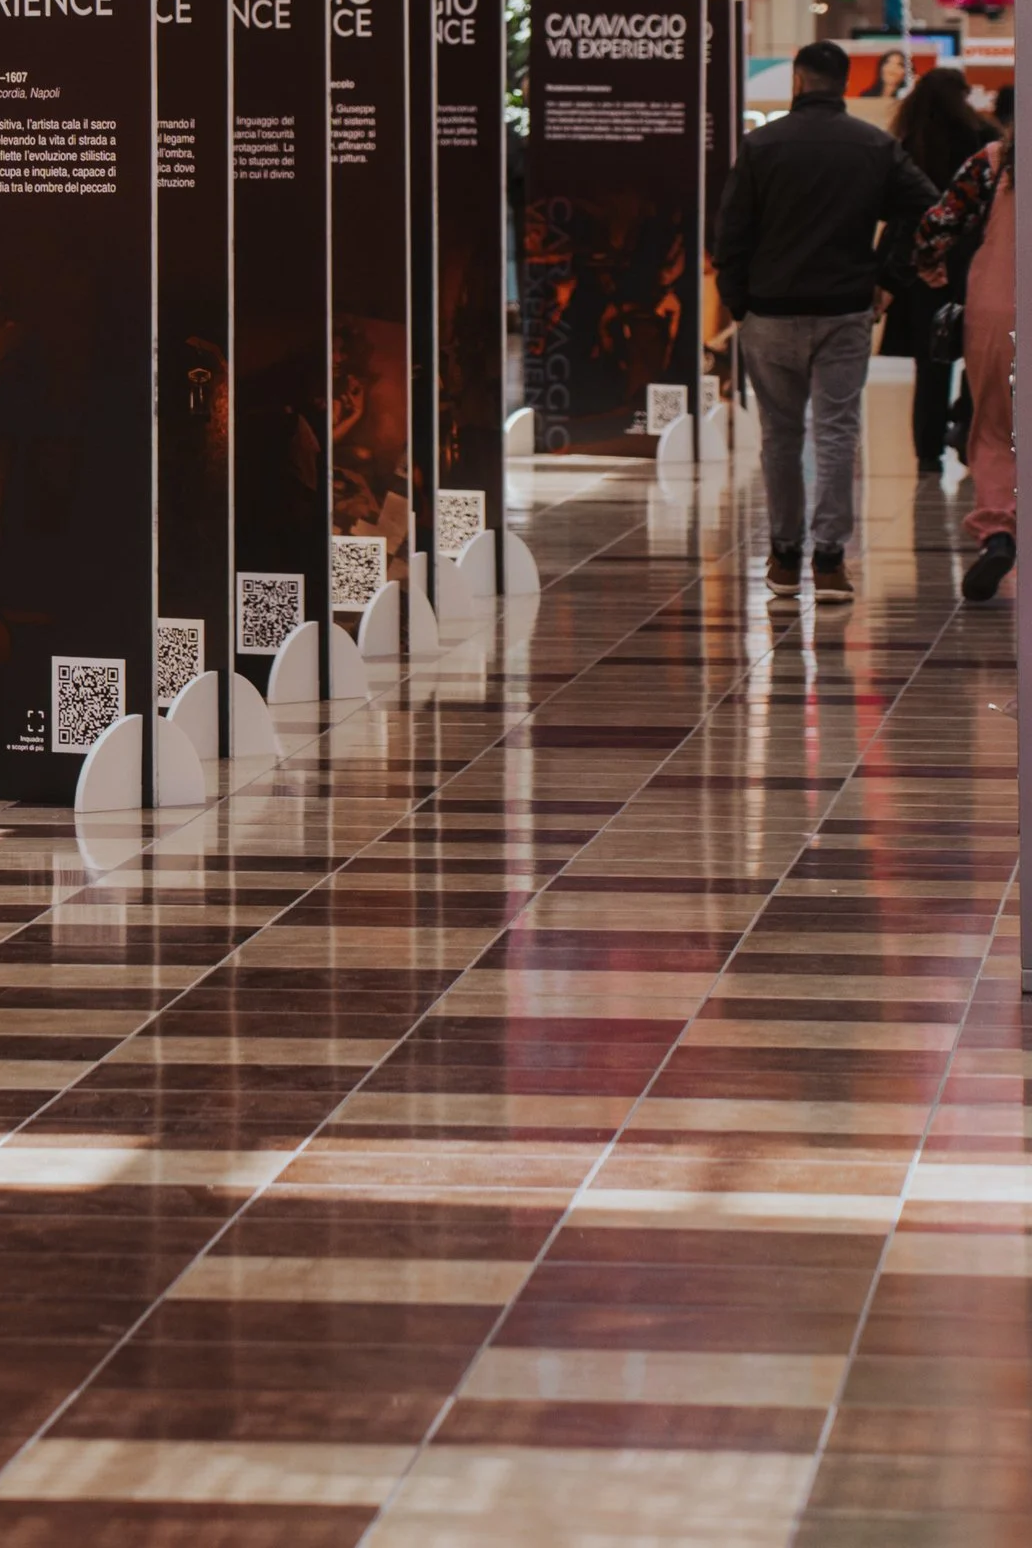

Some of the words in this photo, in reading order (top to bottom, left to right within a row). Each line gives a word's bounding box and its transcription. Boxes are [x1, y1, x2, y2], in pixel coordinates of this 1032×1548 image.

[545, 13, 687, 38] CARAVAGGIO
[546, 39, 573, 59] VR
[577, 39, 685, 60] EXPERIENCE
[30, 87, 60, 100] Napoli
[62, 119, 81, 130] cala
[91, 120, 117, 130] sacro
[158, 119, 189, 129] rmando
[49, 134, 66, 146] vita
[78, 134, 108, 146] strada
[163, 133, 195, 146] legame
[331, 129, 366, 140] ravaggio
[80, 150, 116, 162] stilistica
[0, 168, 22, 179] cupa
[32, 166, 70, 179] inquieta,
[72, 168, 106, 180] capace
[174, 163, 195, 173] dove
[11, 182, 24, 193] tra
[34, 182, 64, 193] ombre
[64, 182, 79, 193] del
[80, 182, 117, 195] peccato
[158, 177, 195, 189] struzione
